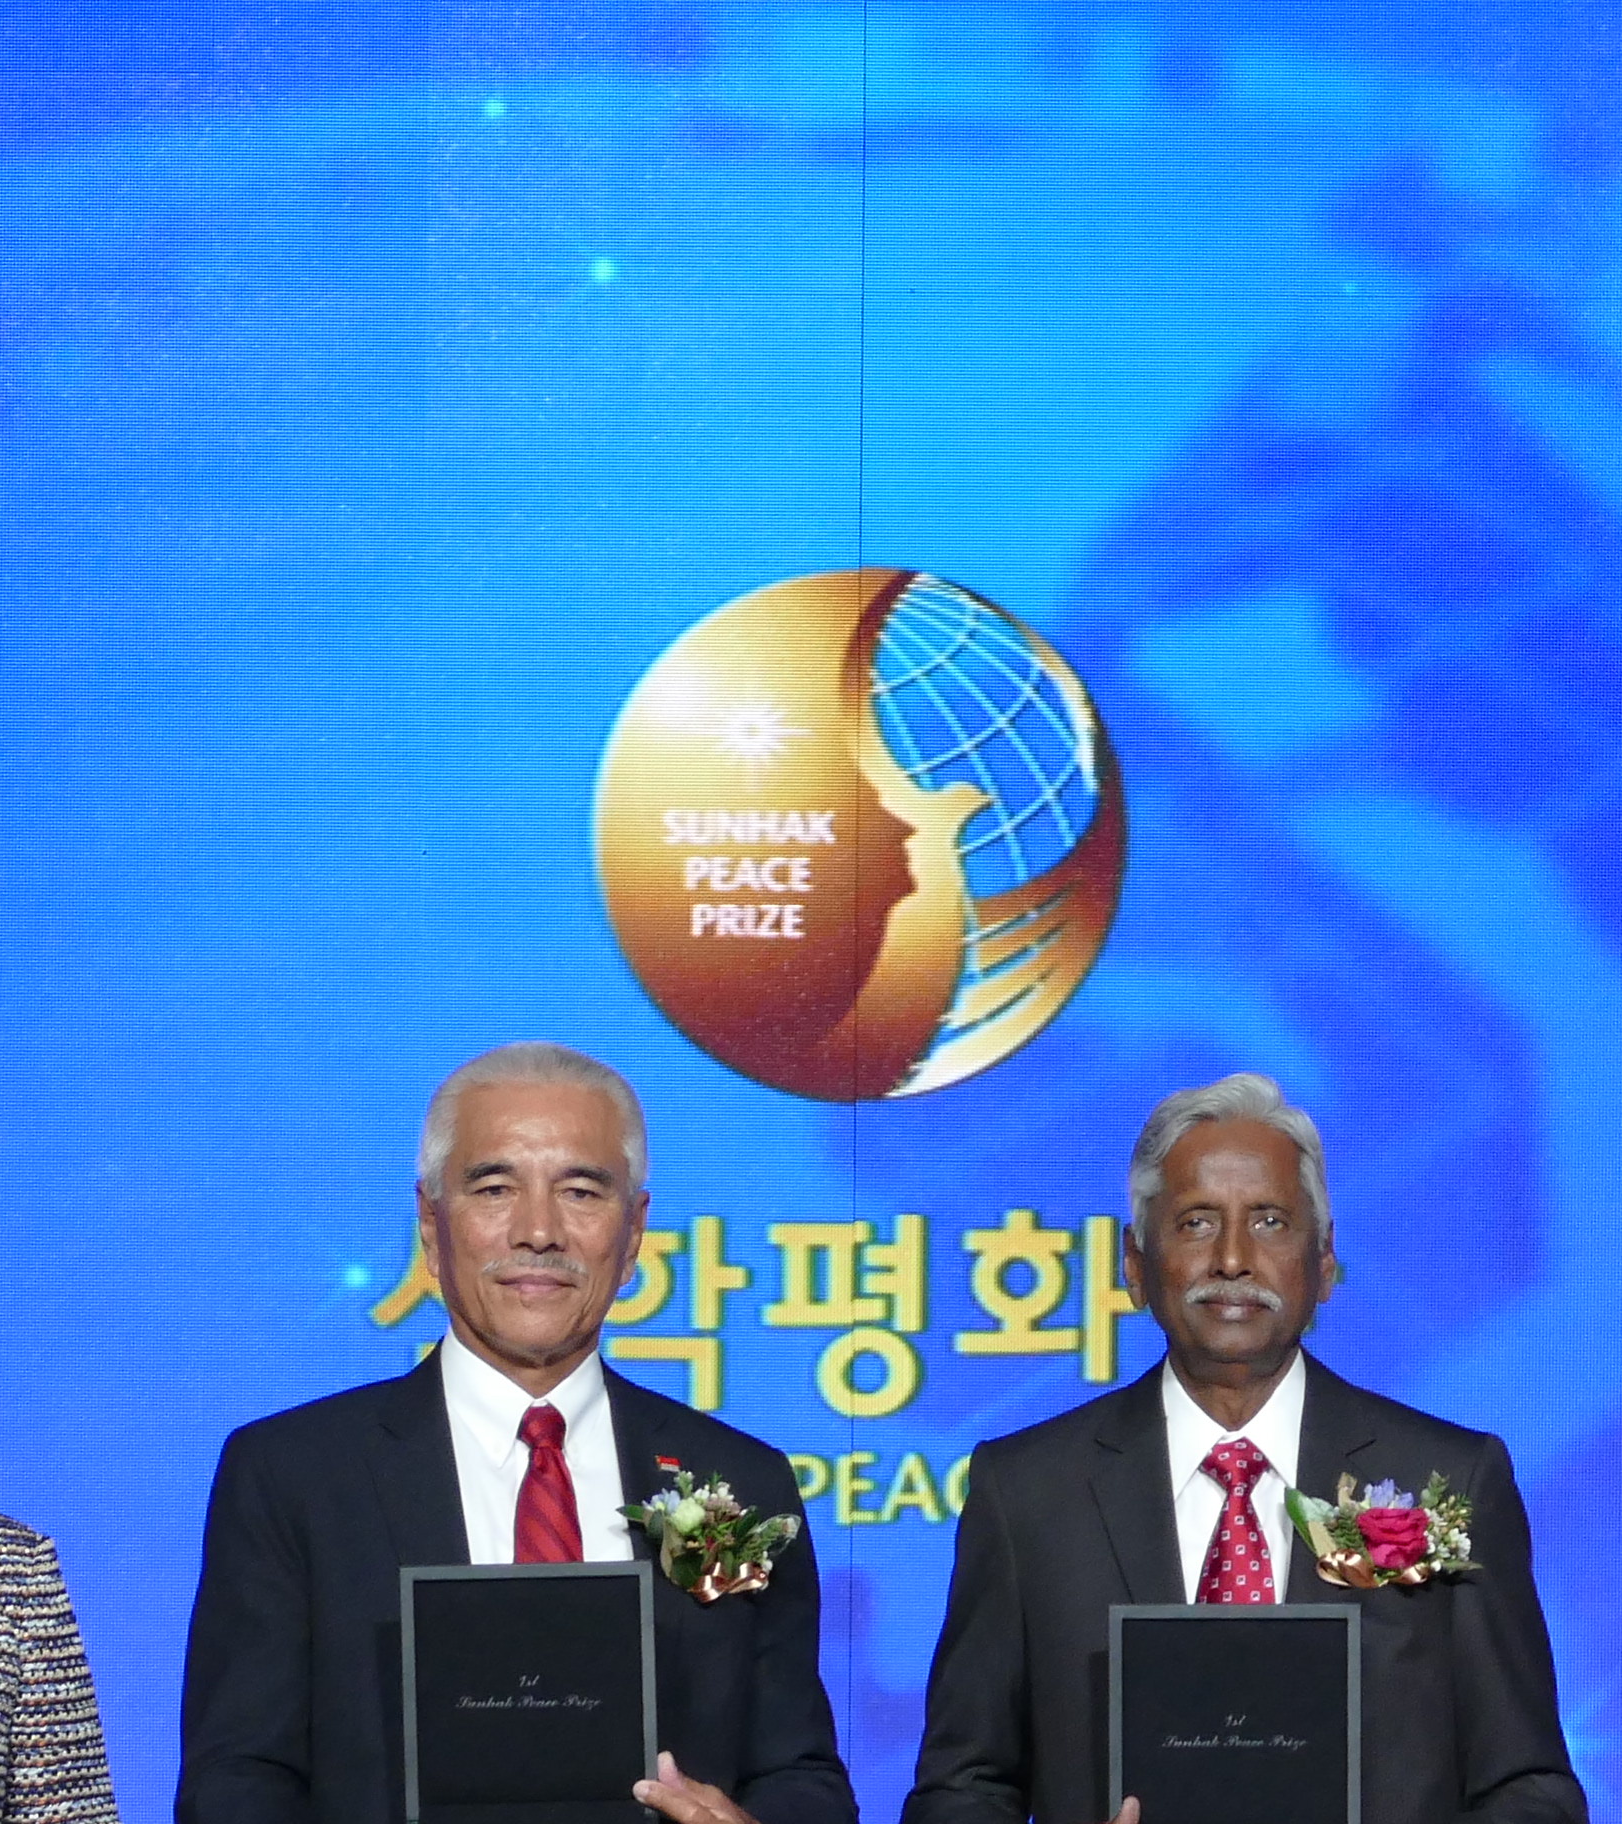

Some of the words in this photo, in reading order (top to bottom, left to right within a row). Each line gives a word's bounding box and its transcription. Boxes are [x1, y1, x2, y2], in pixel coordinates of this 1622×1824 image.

[663, 810, 836, 844] SUNHAK
[684, 857, 813, 892] PEACE
[691, 904, 807, 938] PRIZE
[372, 1208, 1346, 1417] 학평화
